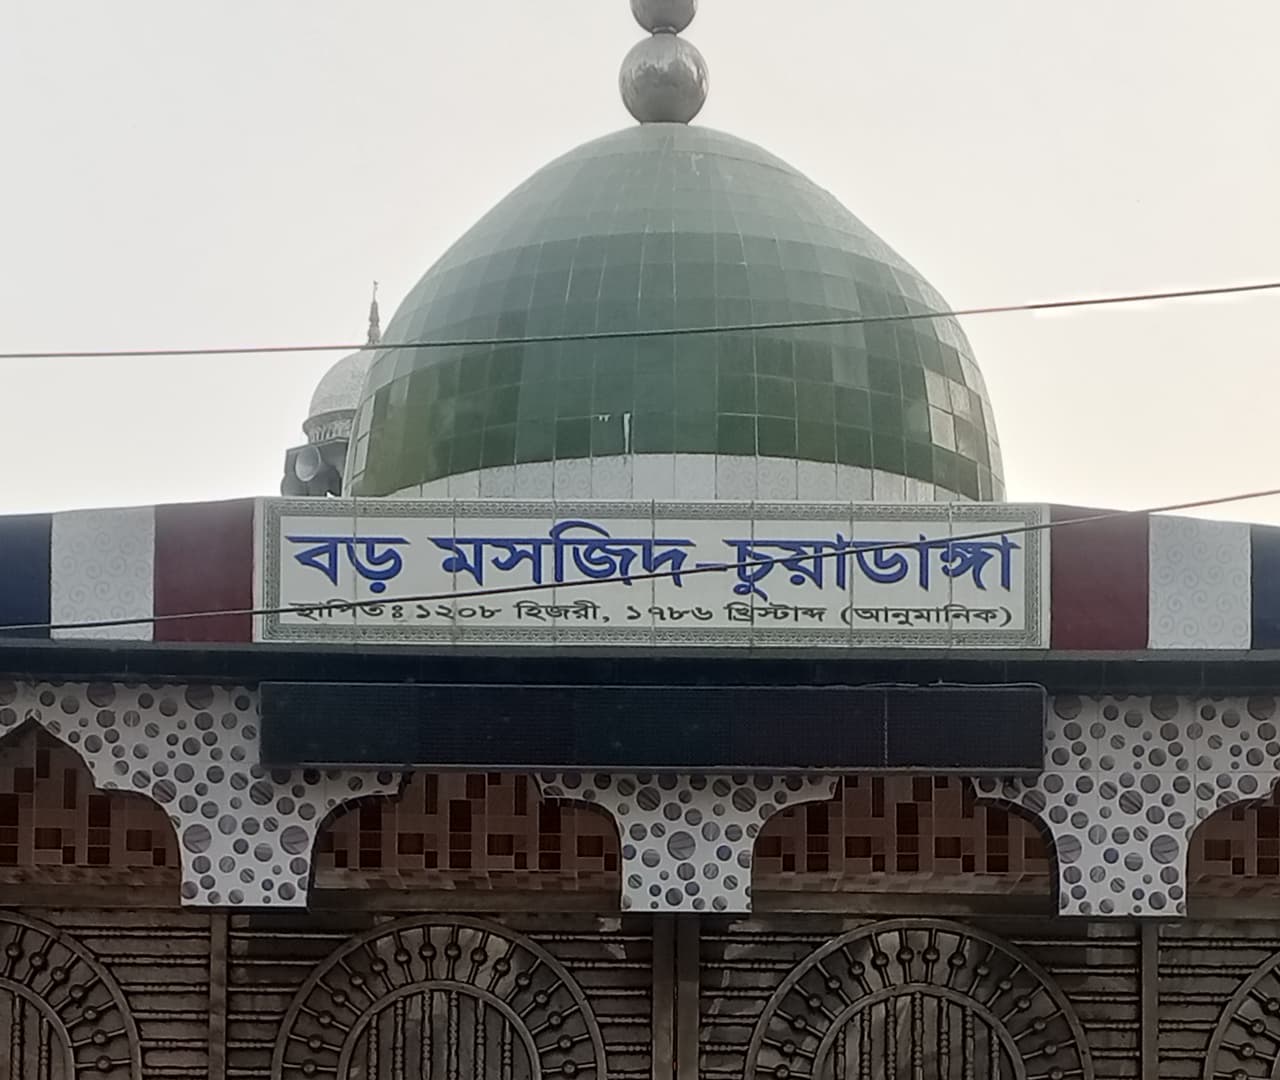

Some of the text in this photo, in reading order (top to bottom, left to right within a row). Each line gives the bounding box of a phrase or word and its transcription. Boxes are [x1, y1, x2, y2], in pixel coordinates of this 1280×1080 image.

[284, 535, 411, 594] বড়
[415, 605, 503, 623] ১২০৮
[516, 600, 611, 623] হিজরী,
[840, 603, 1013, 627] (আনুমানিক)
